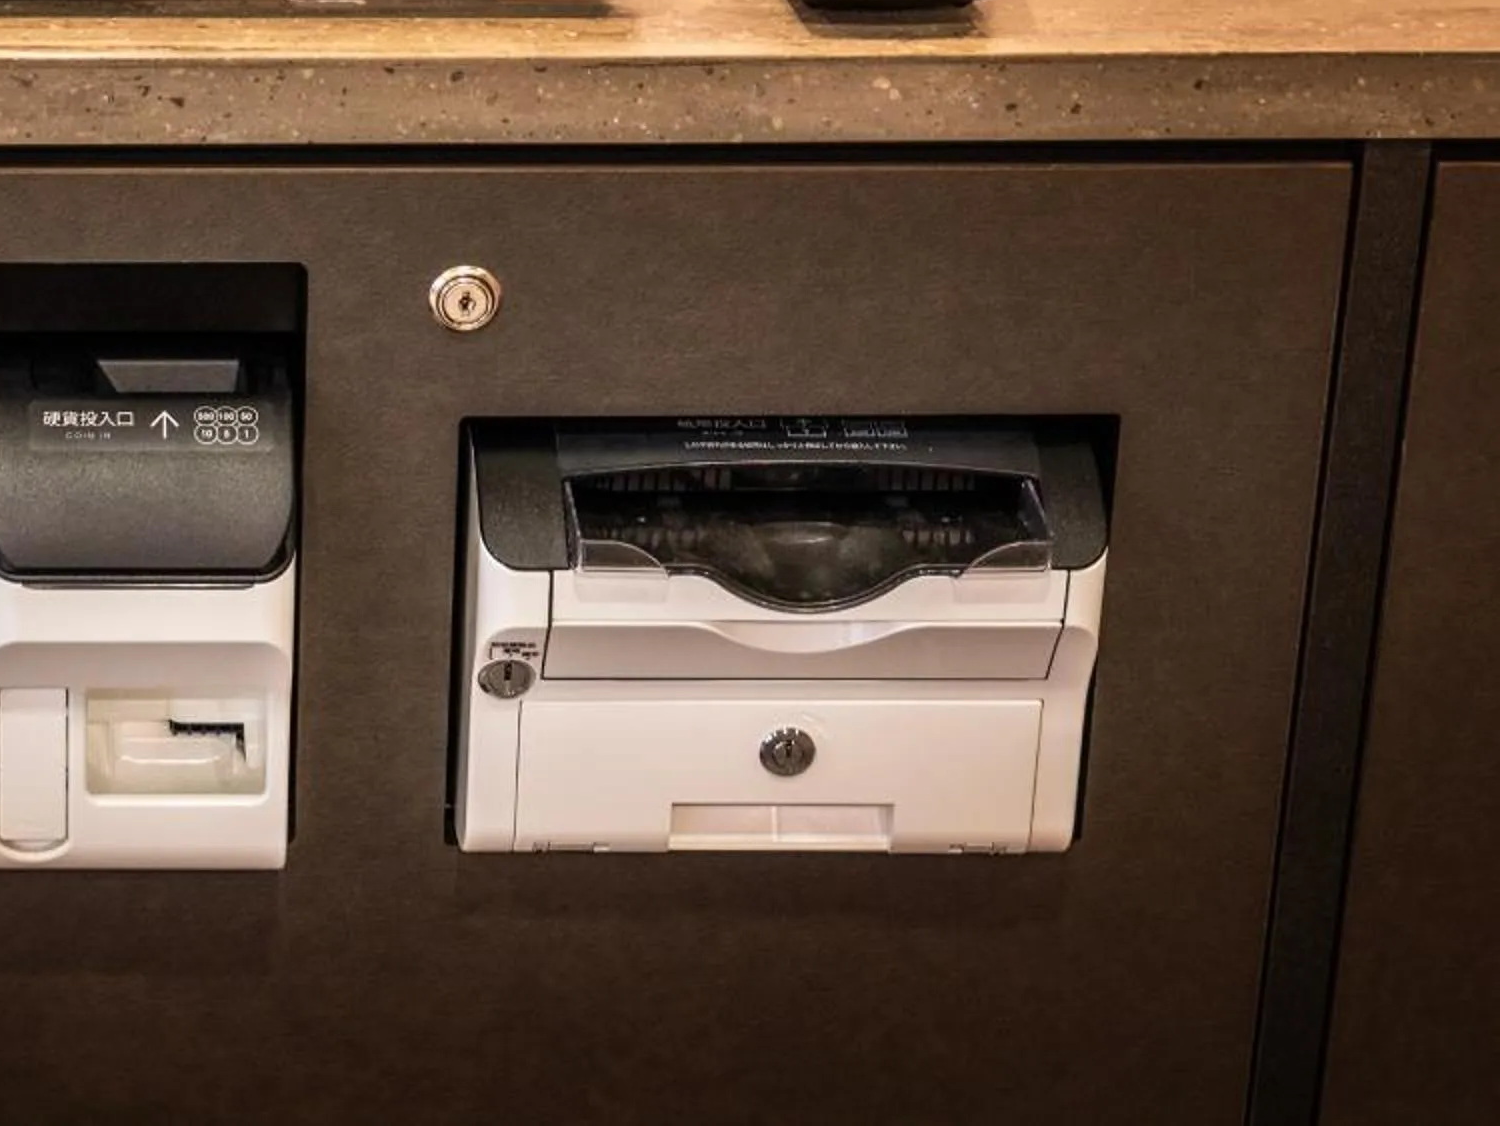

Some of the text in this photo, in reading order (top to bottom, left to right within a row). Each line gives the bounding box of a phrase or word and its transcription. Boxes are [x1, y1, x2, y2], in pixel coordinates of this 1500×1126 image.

[43, 410, 136, 427] 硬貨投入口
